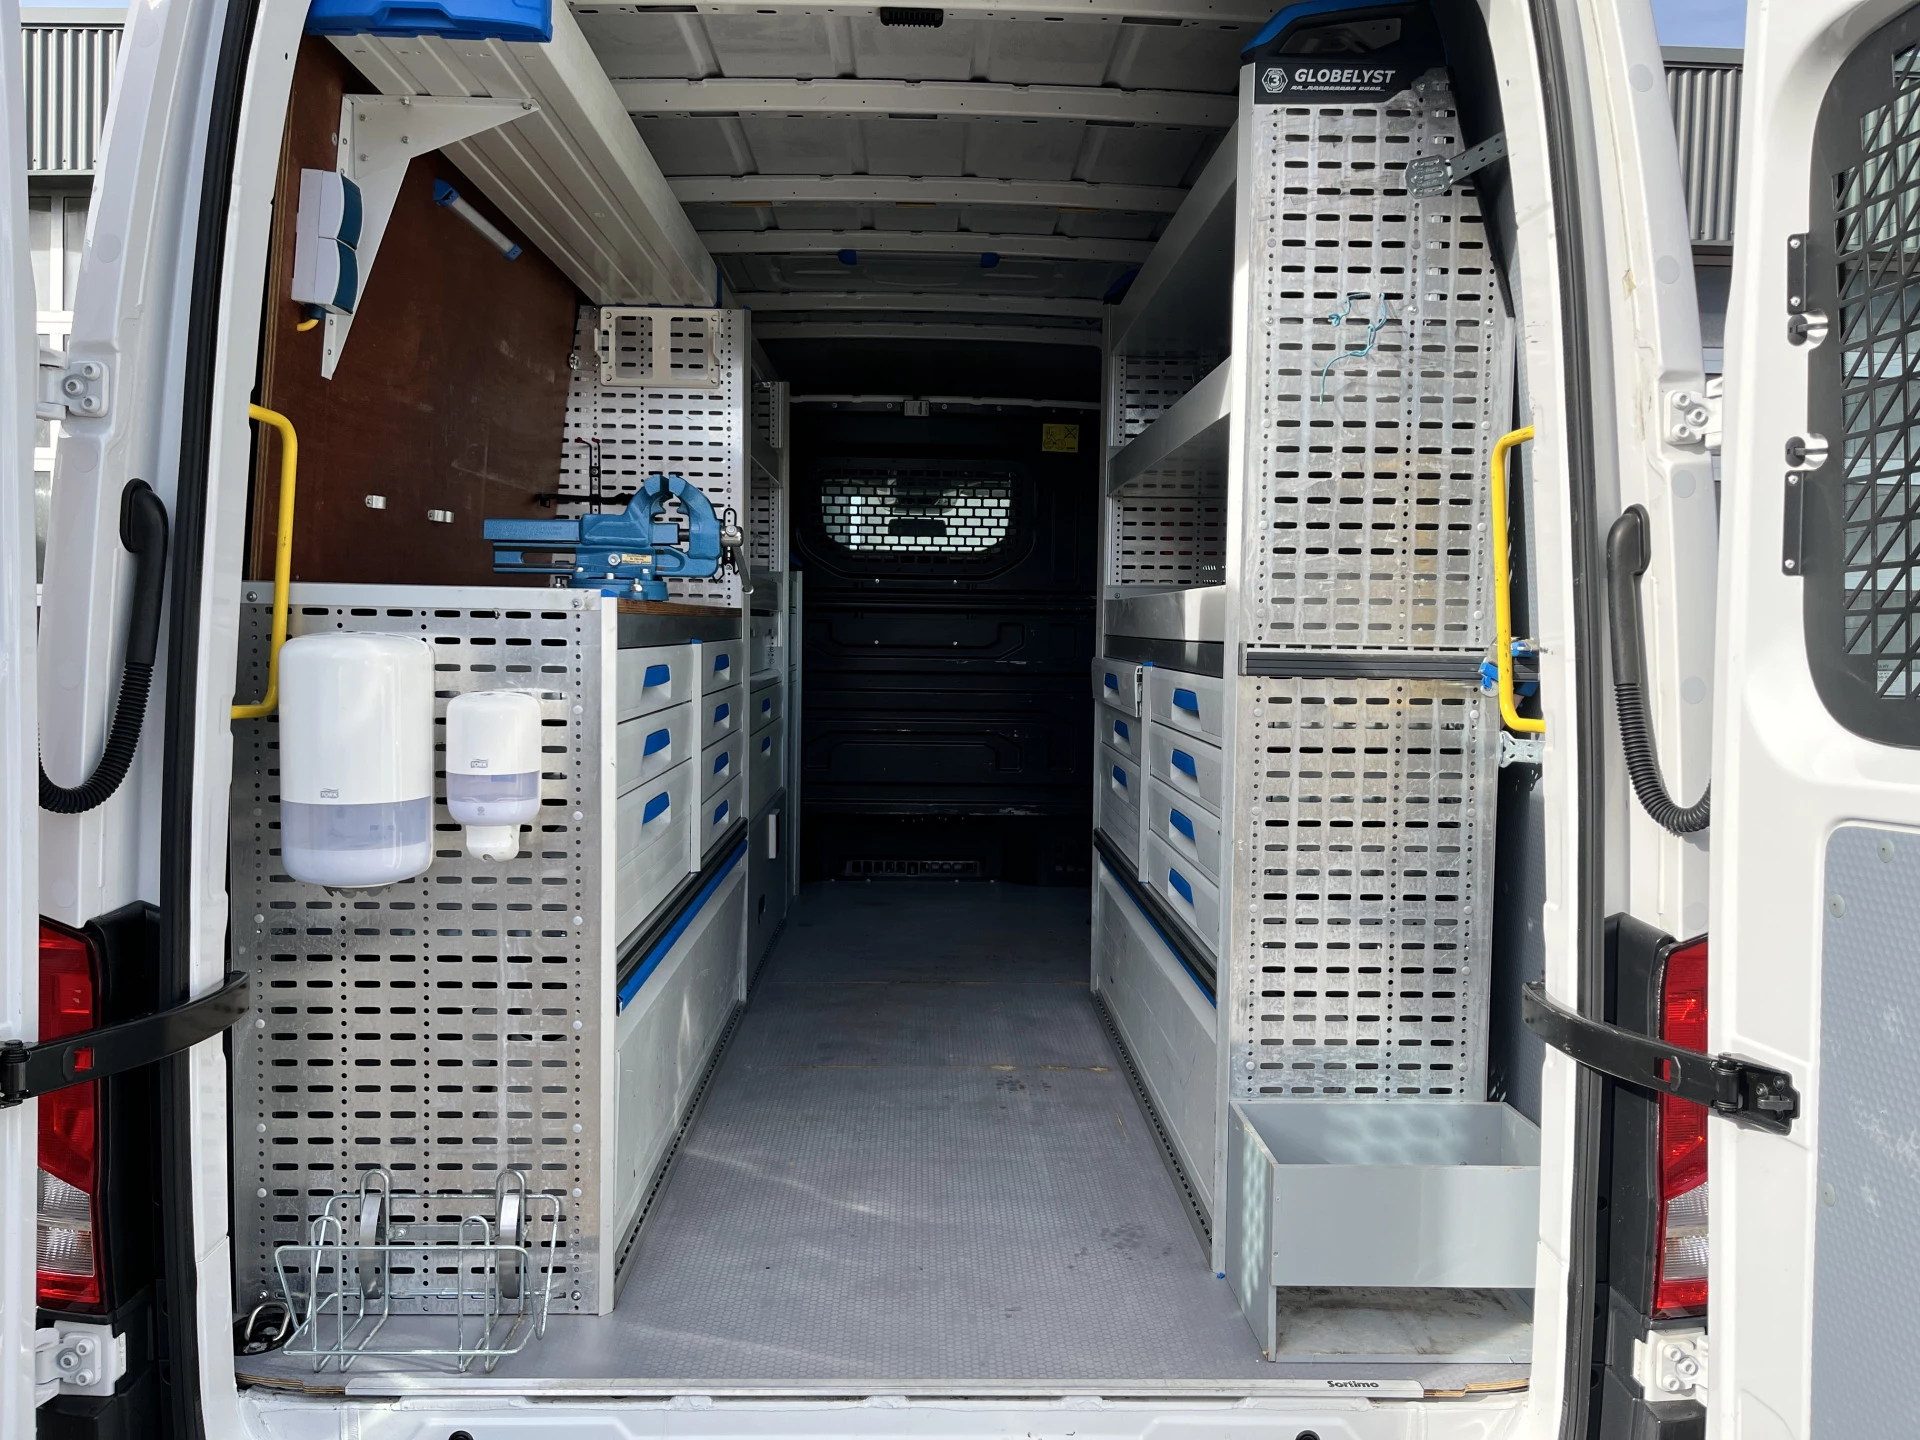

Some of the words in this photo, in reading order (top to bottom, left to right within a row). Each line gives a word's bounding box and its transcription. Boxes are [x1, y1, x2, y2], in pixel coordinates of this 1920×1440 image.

[1270, 75, 1280, 87] 3
[1294, 68, 1396, 84] GLOBELYST
[320, 791, 339, 799] TORK
[1327, 1380, 1380, 1388] Sortimo
